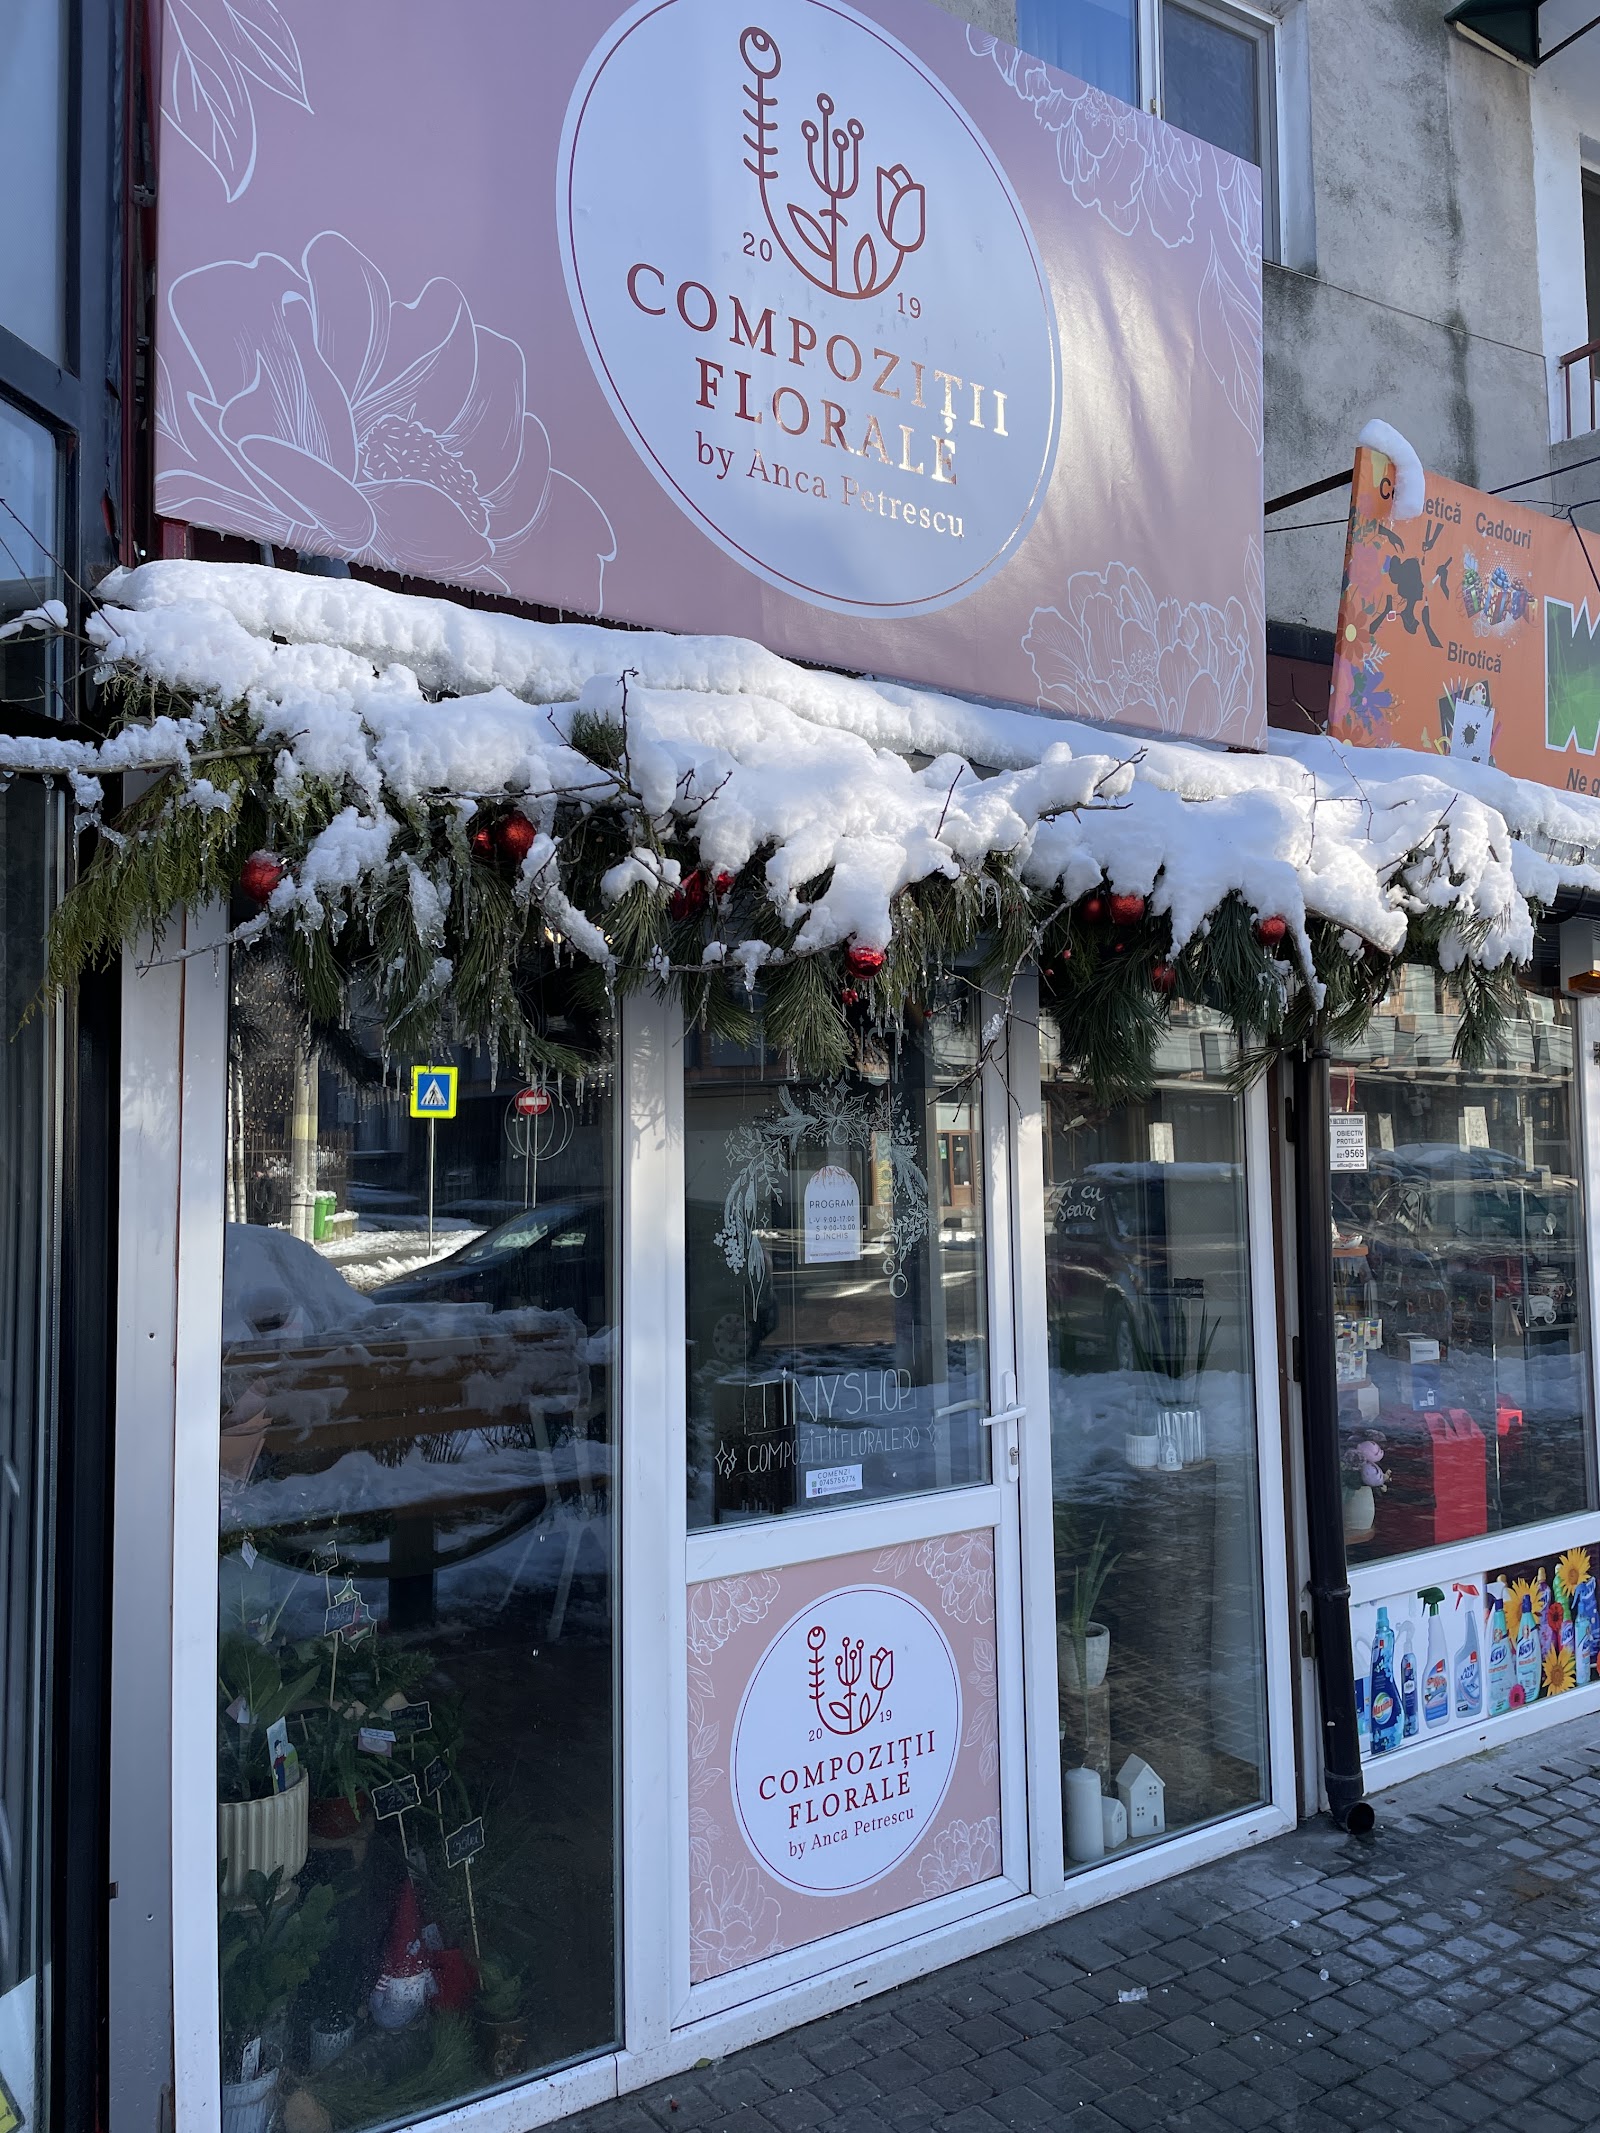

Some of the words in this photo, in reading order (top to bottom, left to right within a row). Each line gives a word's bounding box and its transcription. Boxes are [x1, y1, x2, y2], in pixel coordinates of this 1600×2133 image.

[743, 231, 773, 262] 20
[896, 291, 922, 320] 19
[695, 357, 958, 486] FLORALE
[695, 431, 733, 480] by
[745, 448, 828, 500] Anca
[841, 474, 966, 539] Petrescu
[1379, 476, 1462, 525] Cetică
[1475, 511, 1533, 550] Cadouri
[1447, 640, 1502, 674] Birotică
[1566, 767, 1587, 792] Ne
[809, 1199, 854, 1209] PROGRAM
[1081, 1185, 1105, 1202] cu
[1463, 1663, 1476, 1674] ANTI
[879, 1709, 893, 1723] 19
[808, 1727, 823, 1742] 20
[788, 1771, 912, 1830] FLORALE
[788, 1840, 807, 1860] by
[811, 1828, 849, 1851] Anca
[854, 1807, 915, 1838] Petrescu
